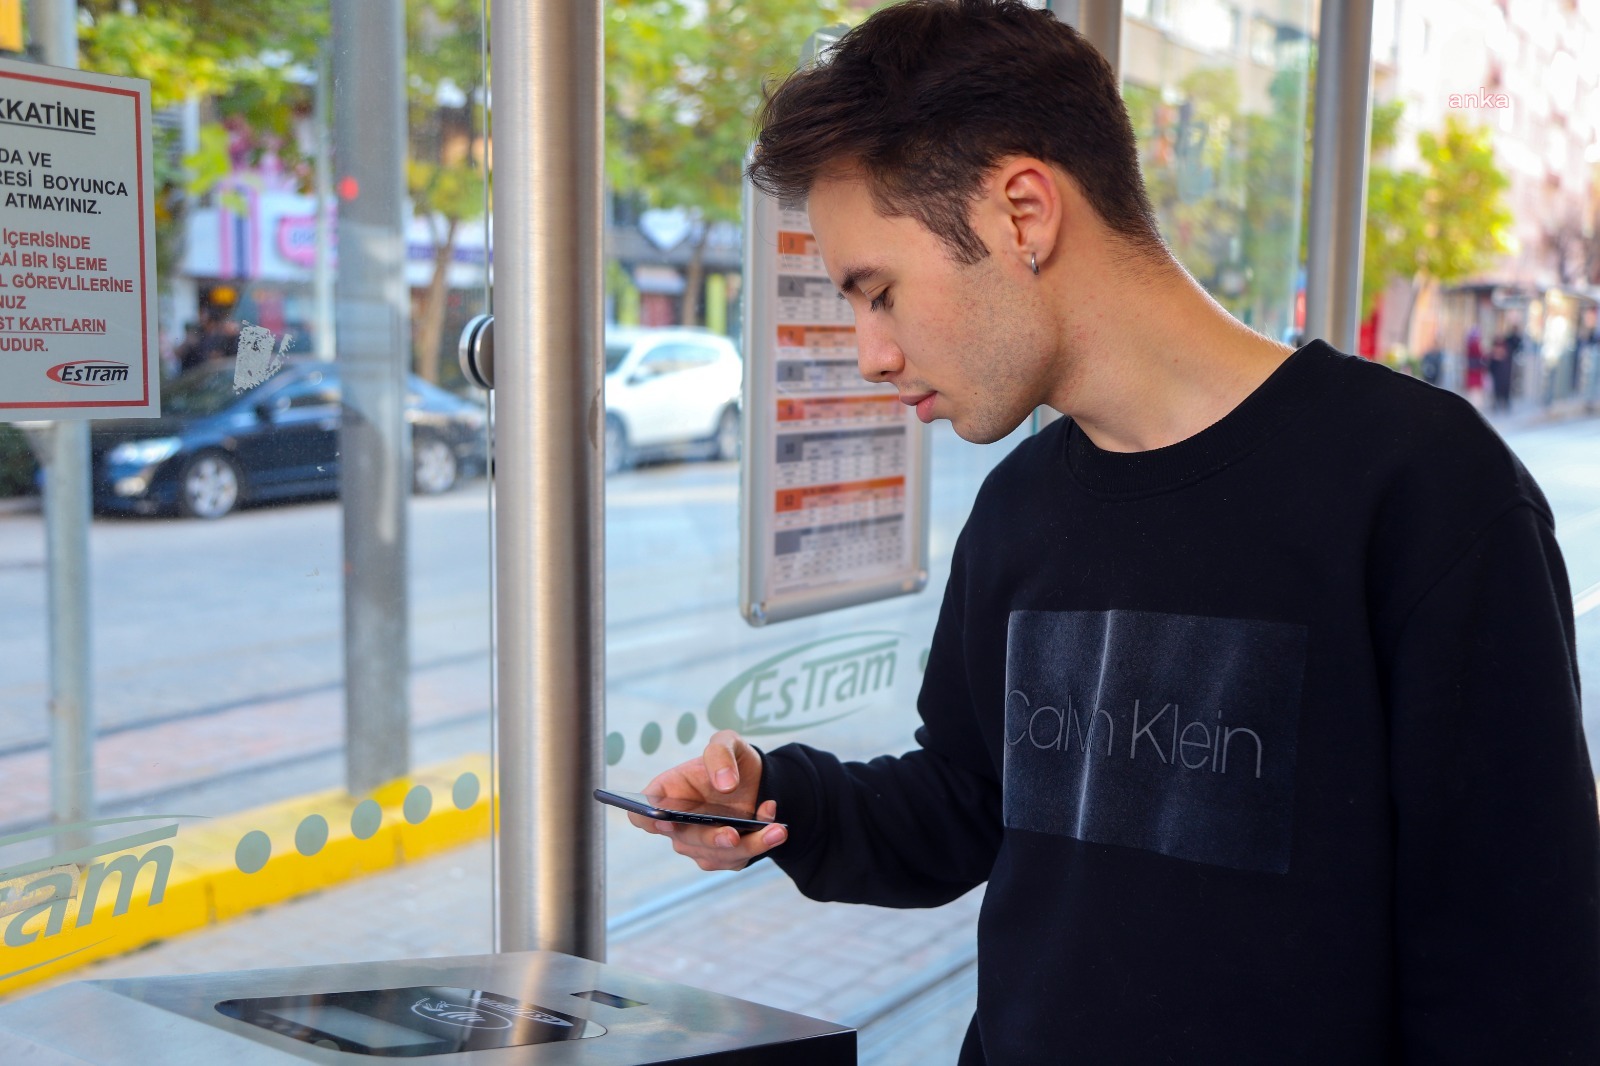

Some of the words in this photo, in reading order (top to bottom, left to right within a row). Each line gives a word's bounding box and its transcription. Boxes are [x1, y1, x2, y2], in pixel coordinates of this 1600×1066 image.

[28, 150, 52, 168] VE
[0, 169, 33, 188] ESİ
[43, 174, 128, 196] BOYUNCA
[5, 192, 101, 215] ATMAYINIZ.
[3, 228, 91, 250] İÇERİSİNDE
[22, 251, 48, 269] BİR
[52, 253, 107, 272] İŞLEME
[12, 272, 133, 293] GÖREVLİLERİNE
[19, 316, 106, 333] KARTLARIN
[744, 638, 898, 729] EsTram
[1130, 699, 1263, 779] Klein
